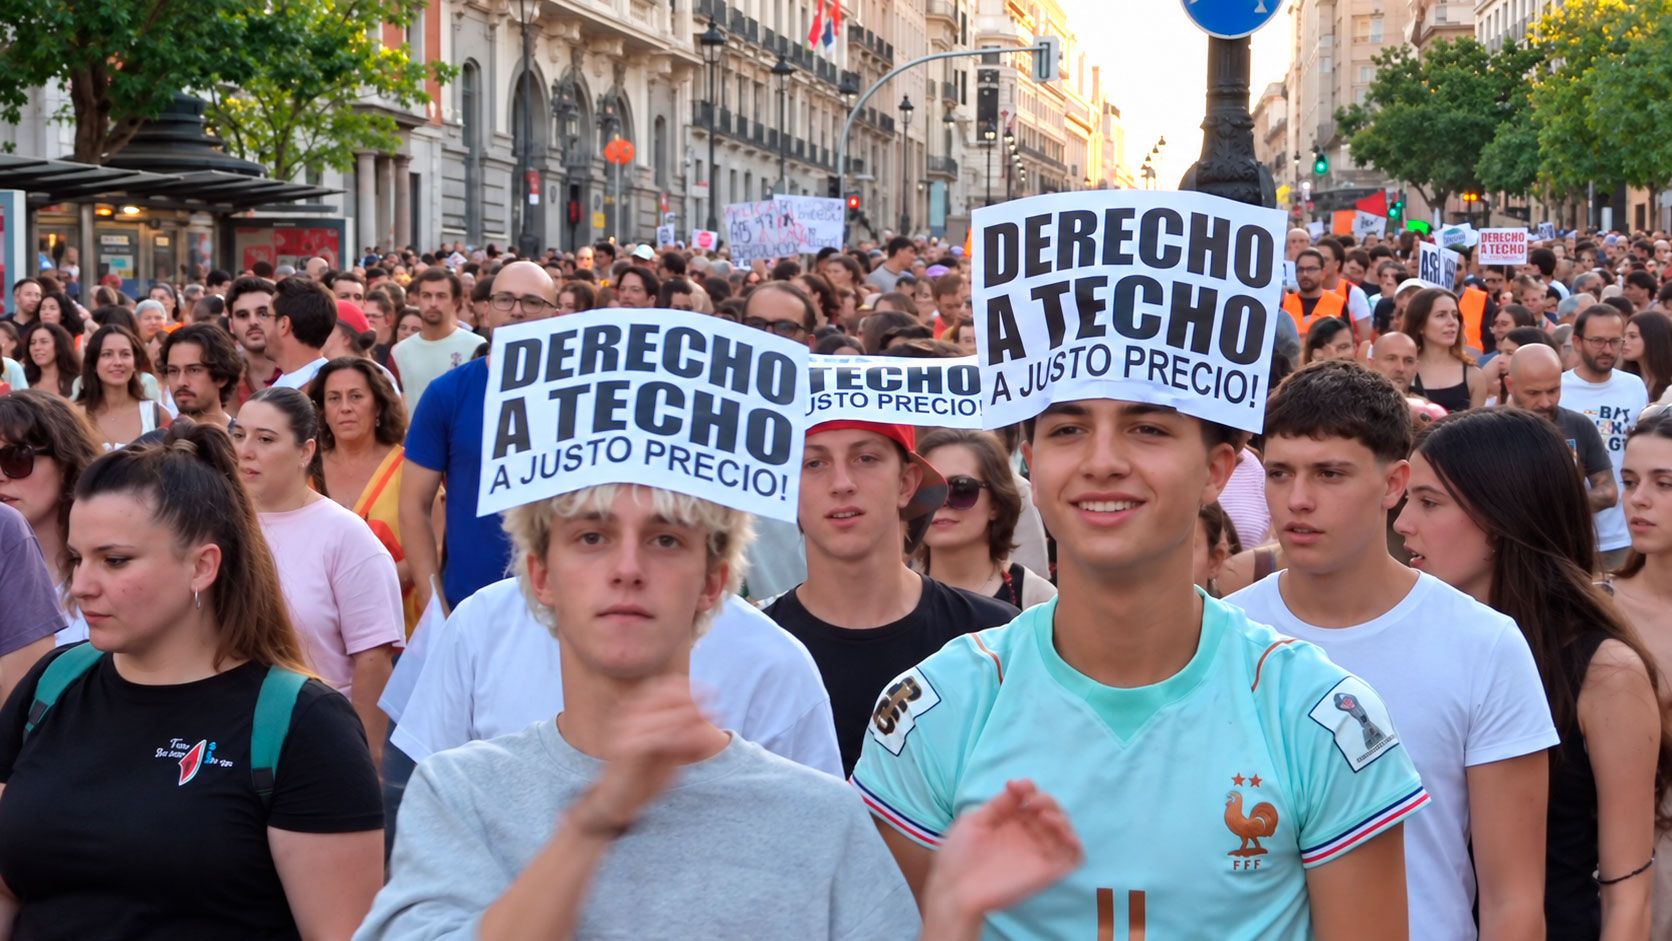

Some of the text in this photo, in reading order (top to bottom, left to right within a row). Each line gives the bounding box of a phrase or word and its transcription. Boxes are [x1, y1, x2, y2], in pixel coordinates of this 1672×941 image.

[983, 207, 1274, 289] DERECHO
[1481, 232, 1525, 243] DERECHO
[1481, 243, 1525, 254] A TECHO
[987, 274, 1267, 366] A TECHO
[500, 323, 797, 406] DERECHO
[808, 365, 982, 396] TECHO
[990, 343, 1259, 408] A JUSTO PRECIO!
[492, 380, 793, 466] A TECHO
[489, 435, 788, 501] A JUSTO PRECIO!
[1233, 859, 1262, 871] FFF
